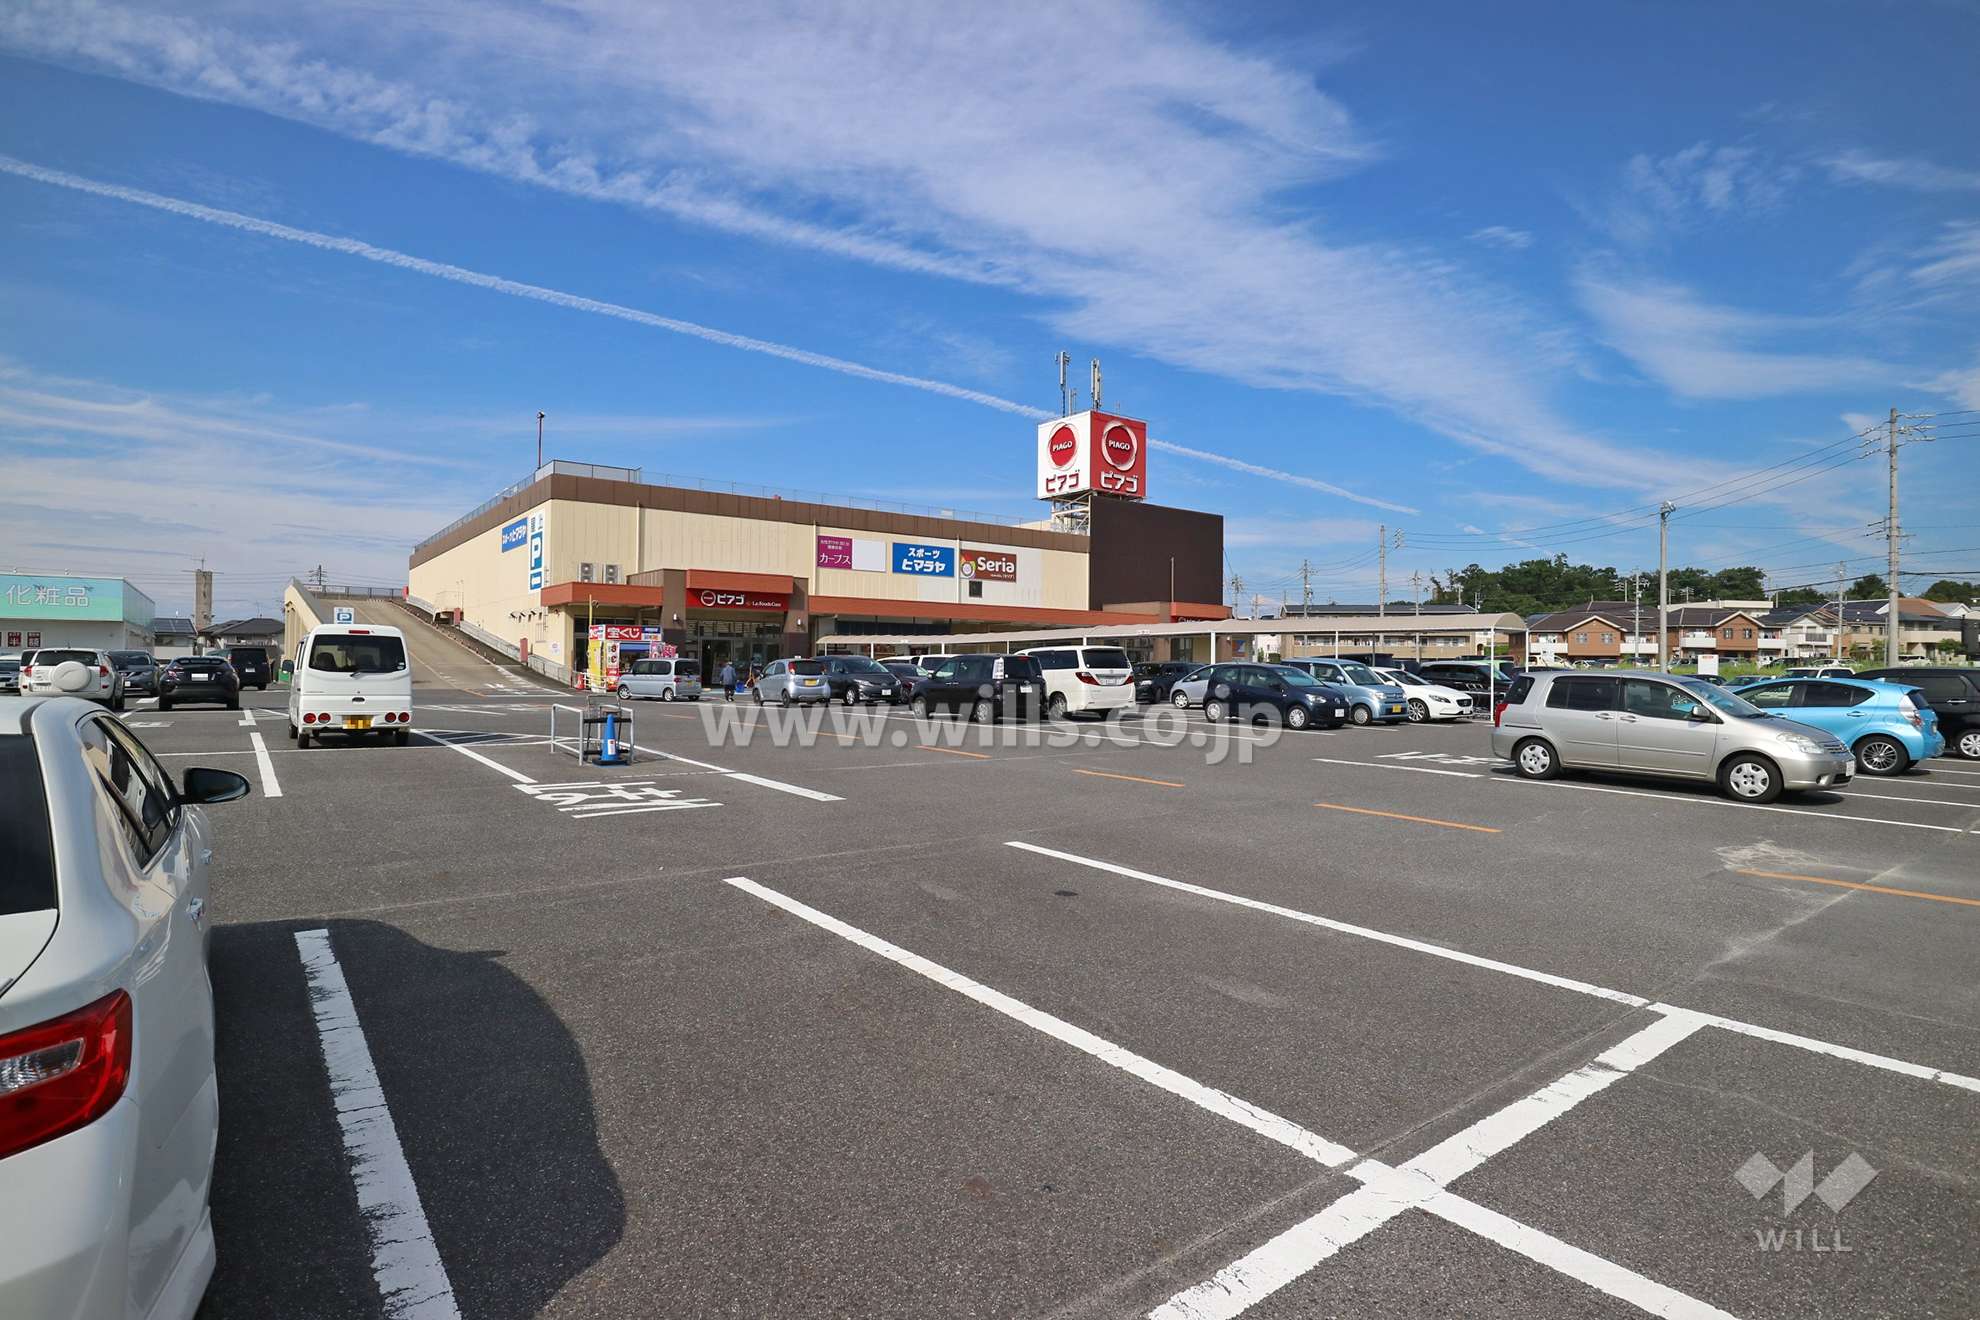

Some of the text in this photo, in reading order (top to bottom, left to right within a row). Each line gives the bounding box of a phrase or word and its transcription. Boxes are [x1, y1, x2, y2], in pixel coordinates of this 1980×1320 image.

[1052, 440, 1073, 452] PIAGO
[1108, 439, 1131, 451] PIAGO
[1045, 469, 1080, 493] ピアゴ
[1100, 471, 1139, 493] ピアゴ
[908, 547, 940, 559] スポーツ
[901, 558, 946, 573] ヒマラヤ
[977, 556, 1015, 573] Seria
[6, 584, 89, 607] 化粧品
[717, 593, 745, 605] ピアゴ
[607, 627, 640, 638] 宝くじ
